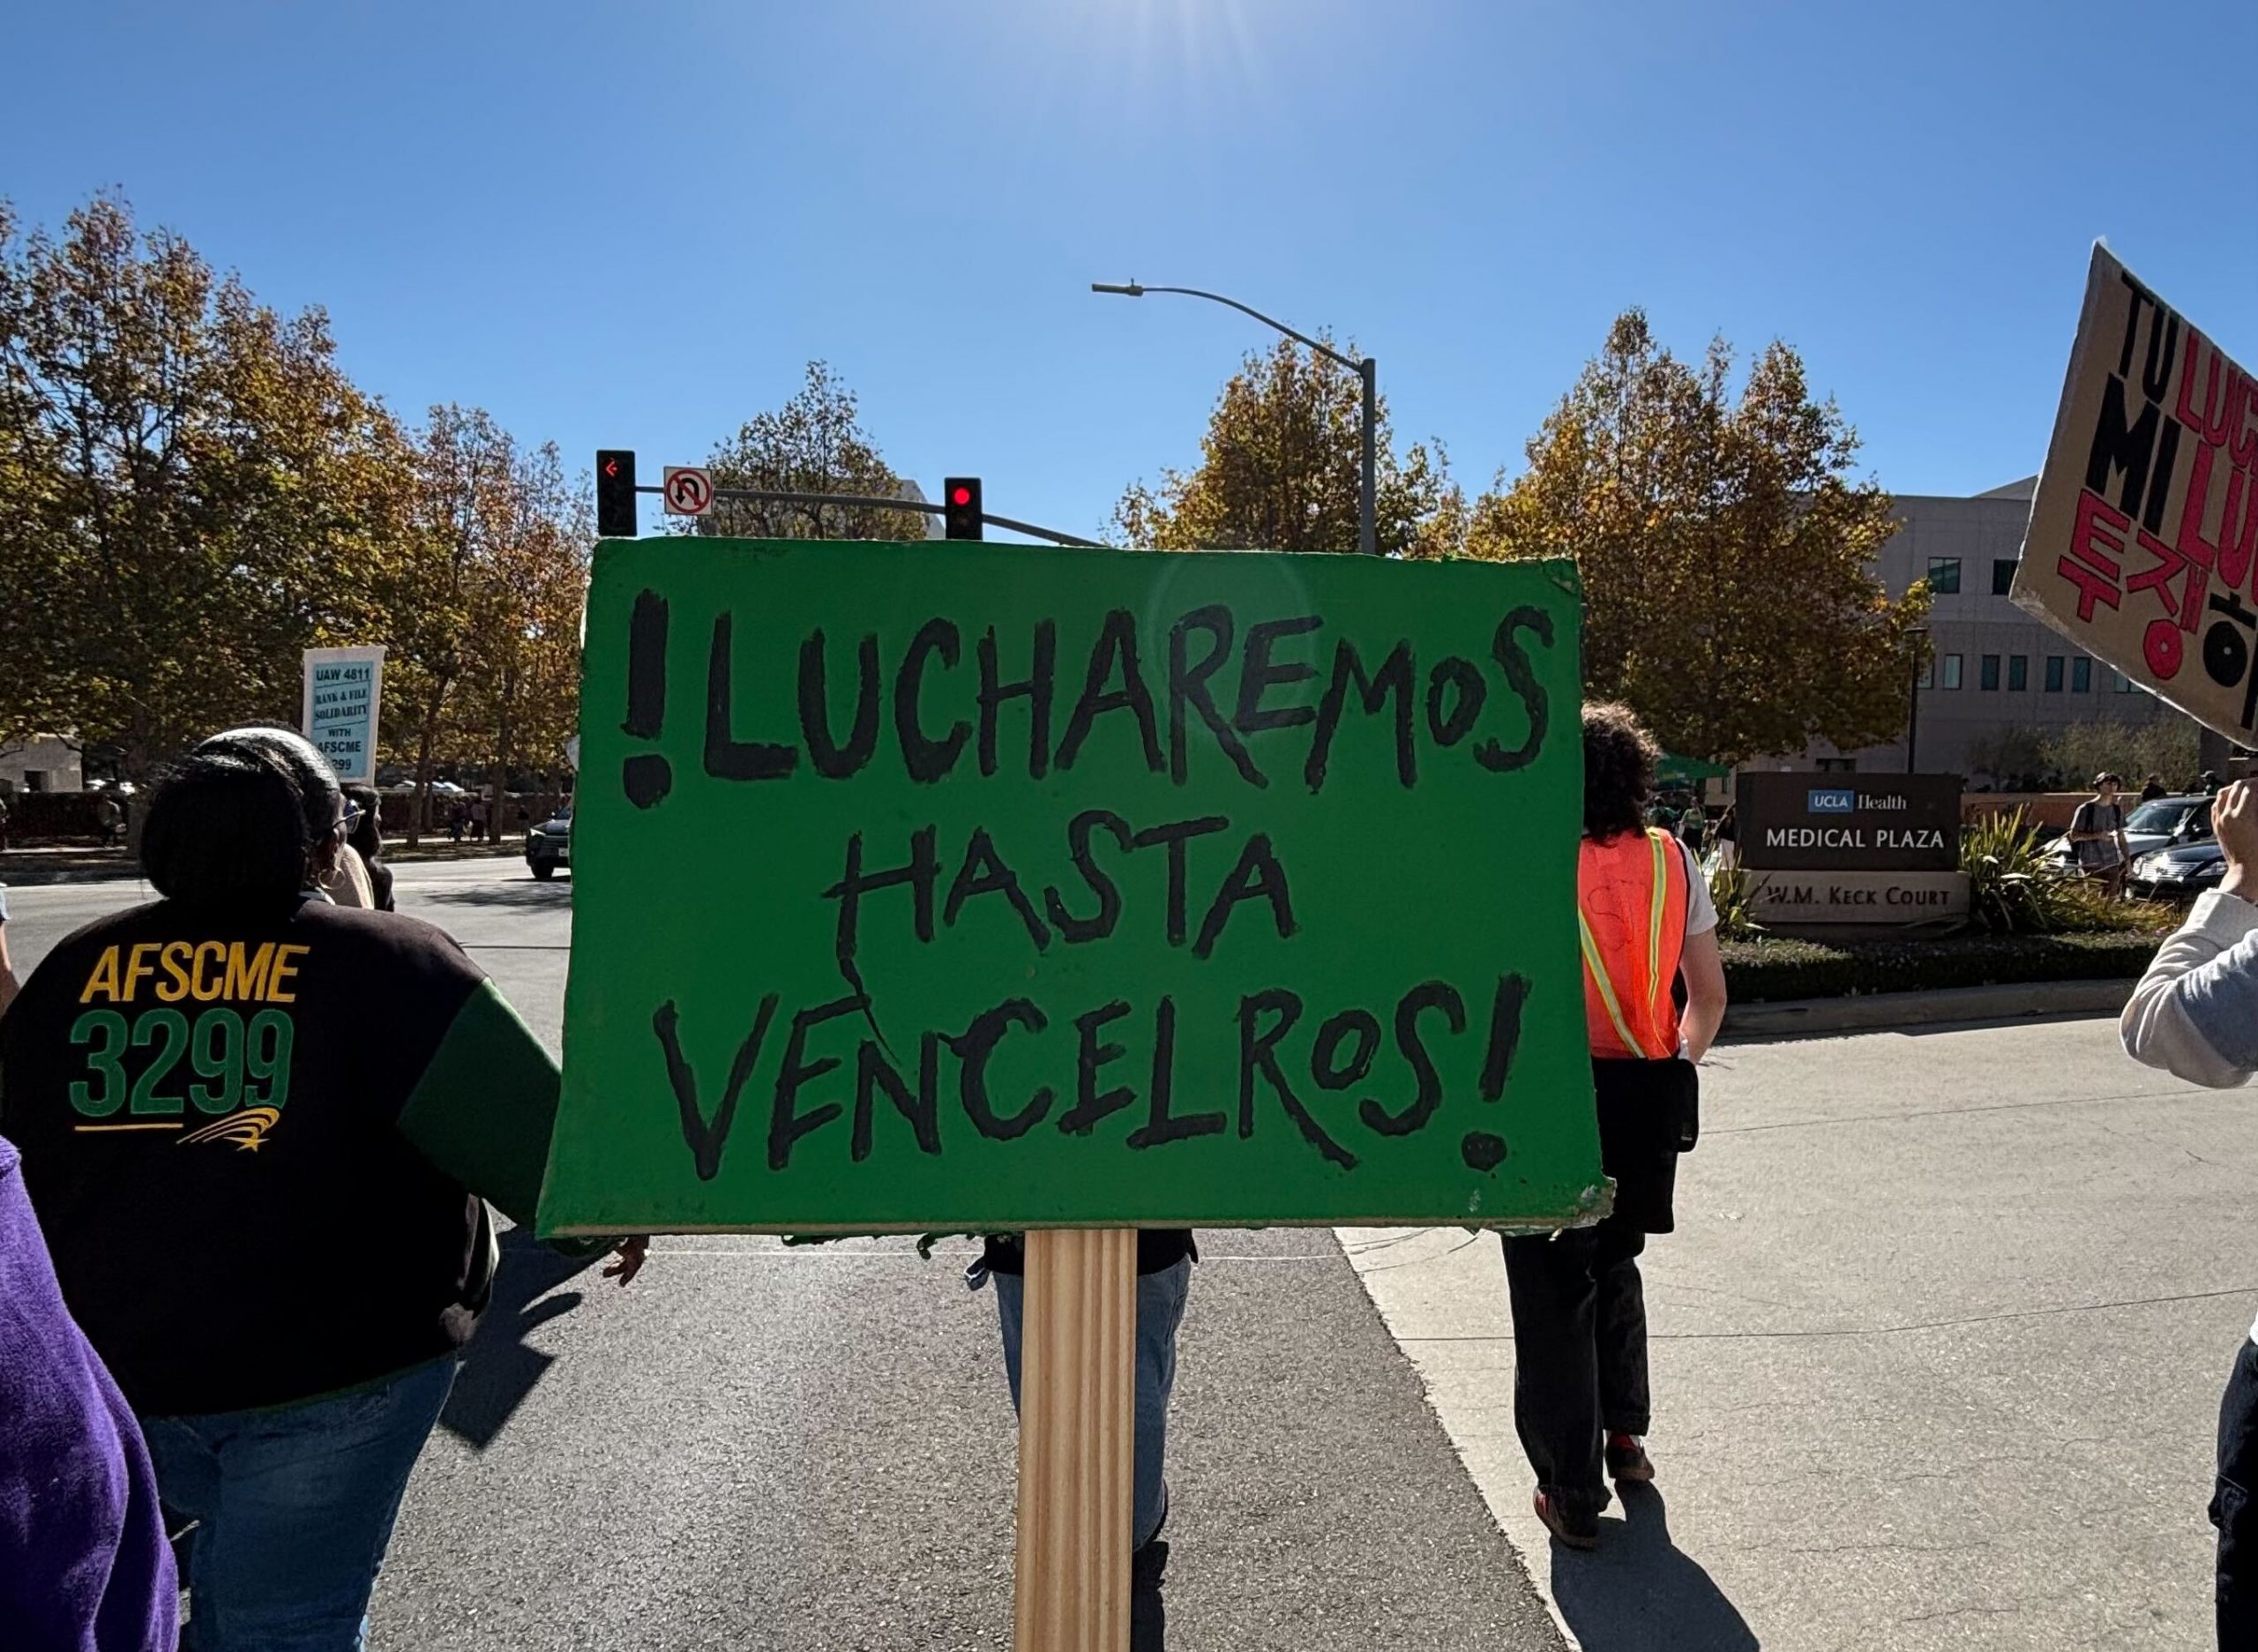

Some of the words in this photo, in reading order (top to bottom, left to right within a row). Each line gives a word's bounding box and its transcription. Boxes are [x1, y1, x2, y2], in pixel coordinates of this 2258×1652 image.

[2119, 272, 2179, 405] TU
[2175, 325, 2258, 477] LUC
[2086, 371, 2181, 536] MI
[2175, 438, 2258, 610] LU
[316, 669, 341, 681] UAW
[343, 667, 370, 680] 4811
[340, 691, 348, 701] &
[349, 689, 367, 700] FILE
[315, 705, 367, 721] SOLIDARITY
[328, 728, 351, 737] WITH
[332, 759, 352, 771] 299
[1813, 796, 1849, 809] UCLA
[1858, 794, 1907, 811] Health
[1766, 827, 1866, 848] MEDICAL
[1875, 828, 1944, 848] PLAZA
[821, 809, 1300, 960] HASTA
[1767, 885, 1820, 905] W.M.
[79, 940, 310, 1003] AFSCME
[70, 1007, 294, 1118] 3299
[653, 971, 1532, 1182] VENCELROS!
